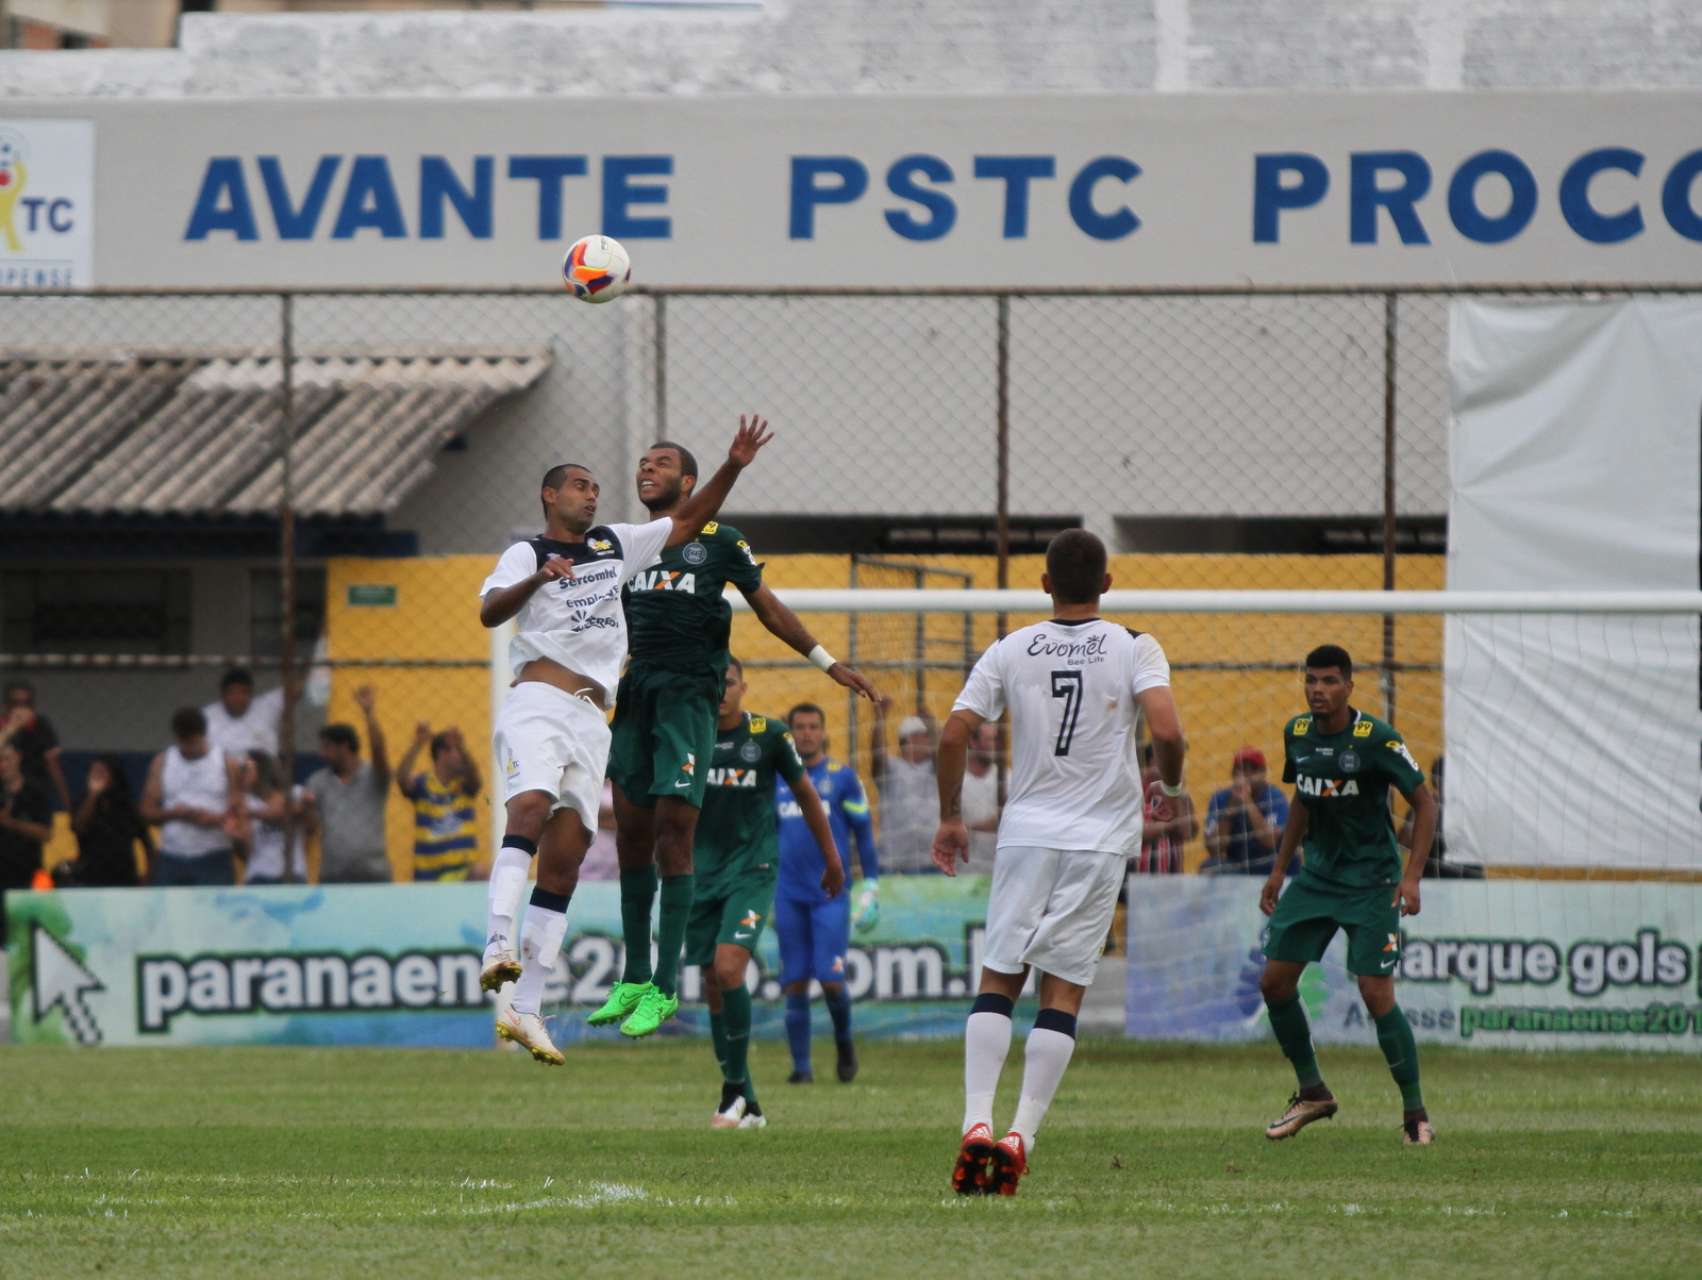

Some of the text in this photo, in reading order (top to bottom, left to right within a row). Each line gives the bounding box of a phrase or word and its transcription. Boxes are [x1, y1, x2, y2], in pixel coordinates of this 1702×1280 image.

[182, 155, 673, 240] AVANTE
[788, 154, 1142, 242] PSTC
[1051, 670, 1083, 756] 7
[706, 767, 757, 787] AIXA
[1296, 773, 1360, 797] CAIXA
[1392, 930, 1563, 995] arque
[1569, 927, 1692, 996] gols
